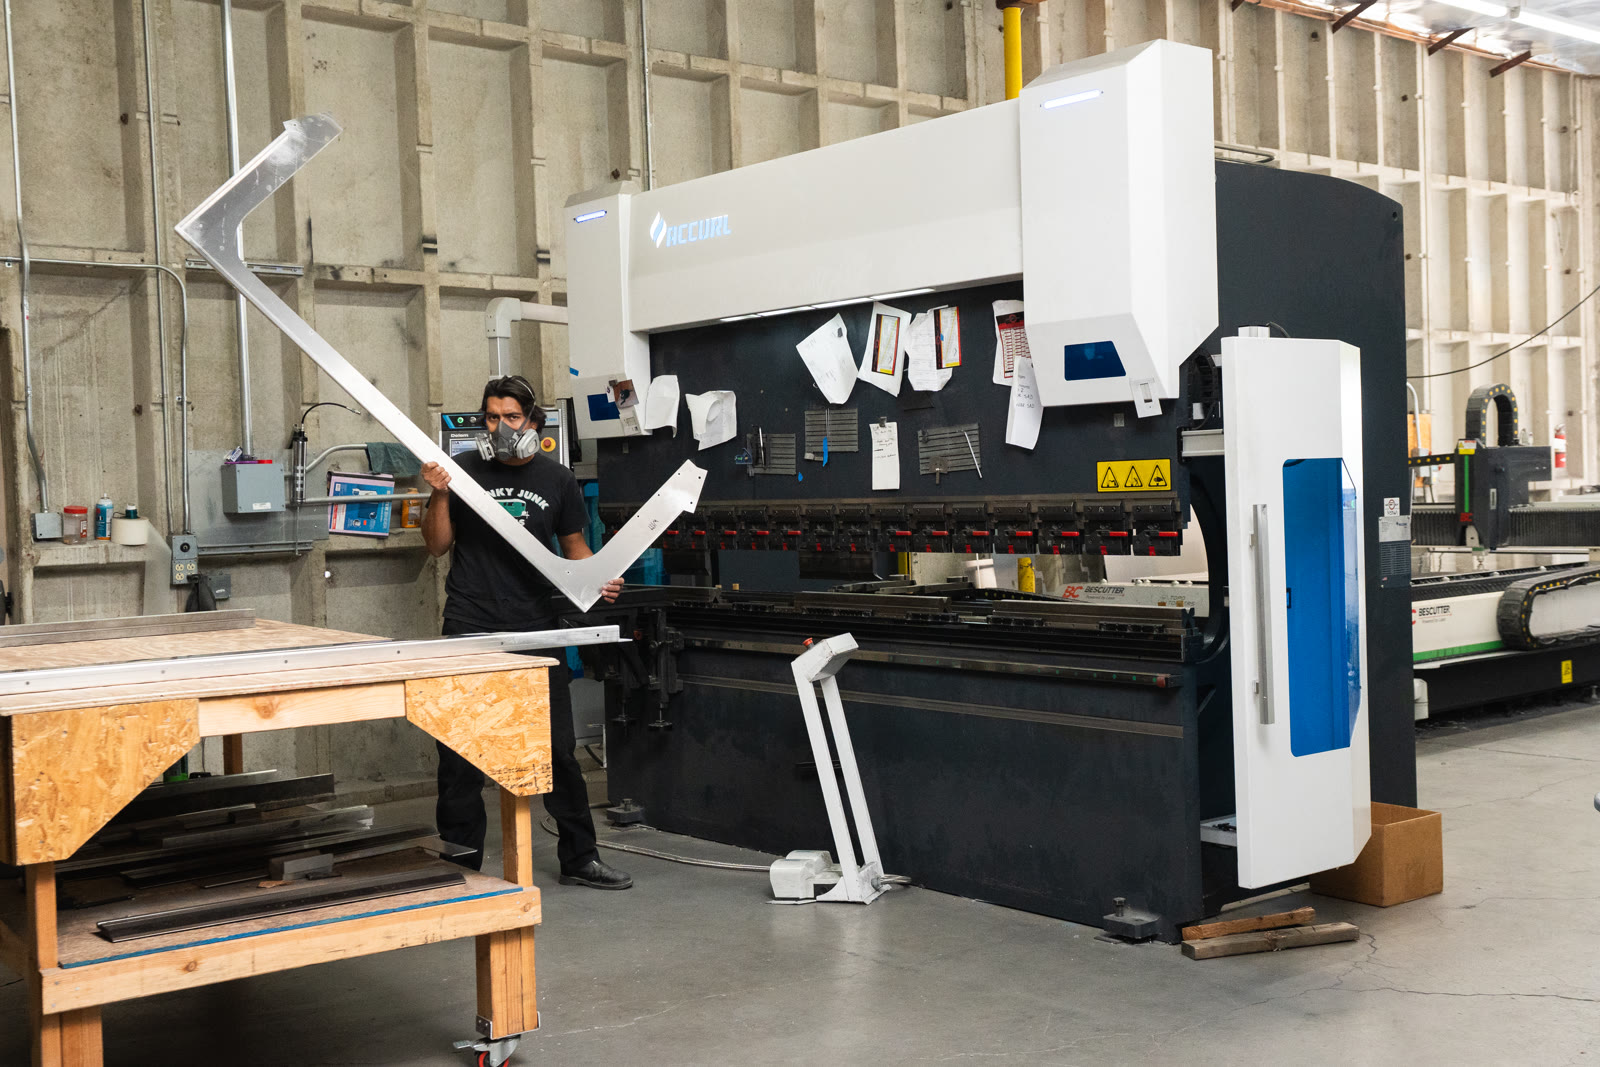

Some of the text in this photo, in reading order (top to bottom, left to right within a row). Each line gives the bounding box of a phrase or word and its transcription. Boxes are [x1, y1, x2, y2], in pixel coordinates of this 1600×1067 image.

[665, 214, 732, 248] ACCURL
[486, 487, 550, 511] NKY JUNK
[1062, 585, 1125, 598] BC BESCUTTER
[1419, 605, 1450, 616] BESCUTTER
